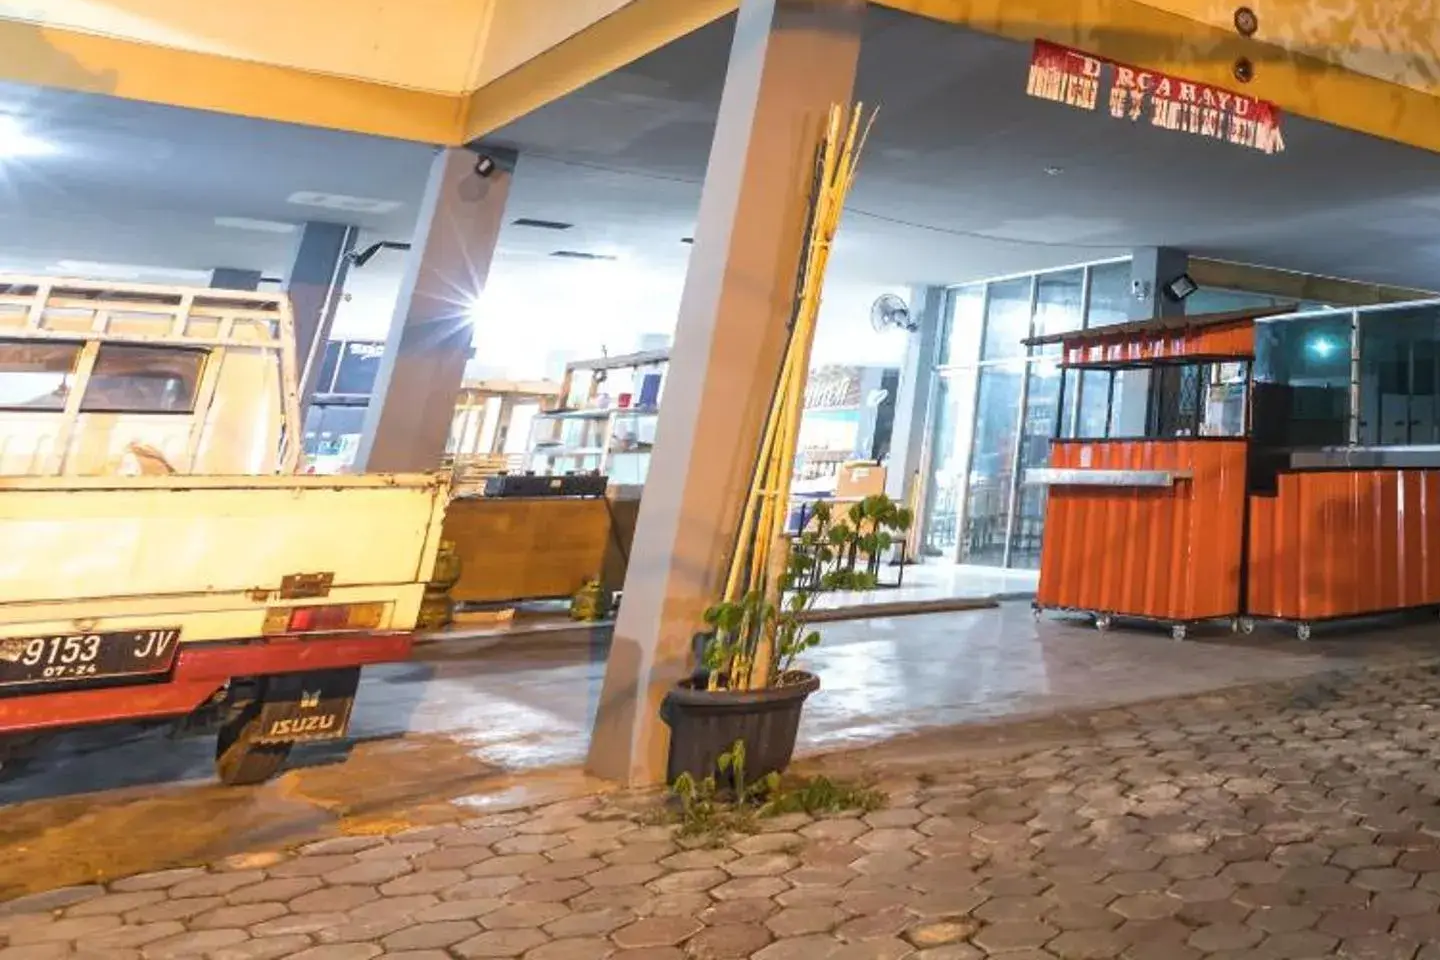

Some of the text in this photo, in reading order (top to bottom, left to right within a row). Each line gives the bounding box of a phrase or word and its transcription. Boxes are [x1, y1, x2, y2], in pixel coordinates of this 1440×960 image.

[23, 635, 100, 666] 9153
[134, 630, 175, 658] JV
[269, 714, 336, 735] ISUZU
